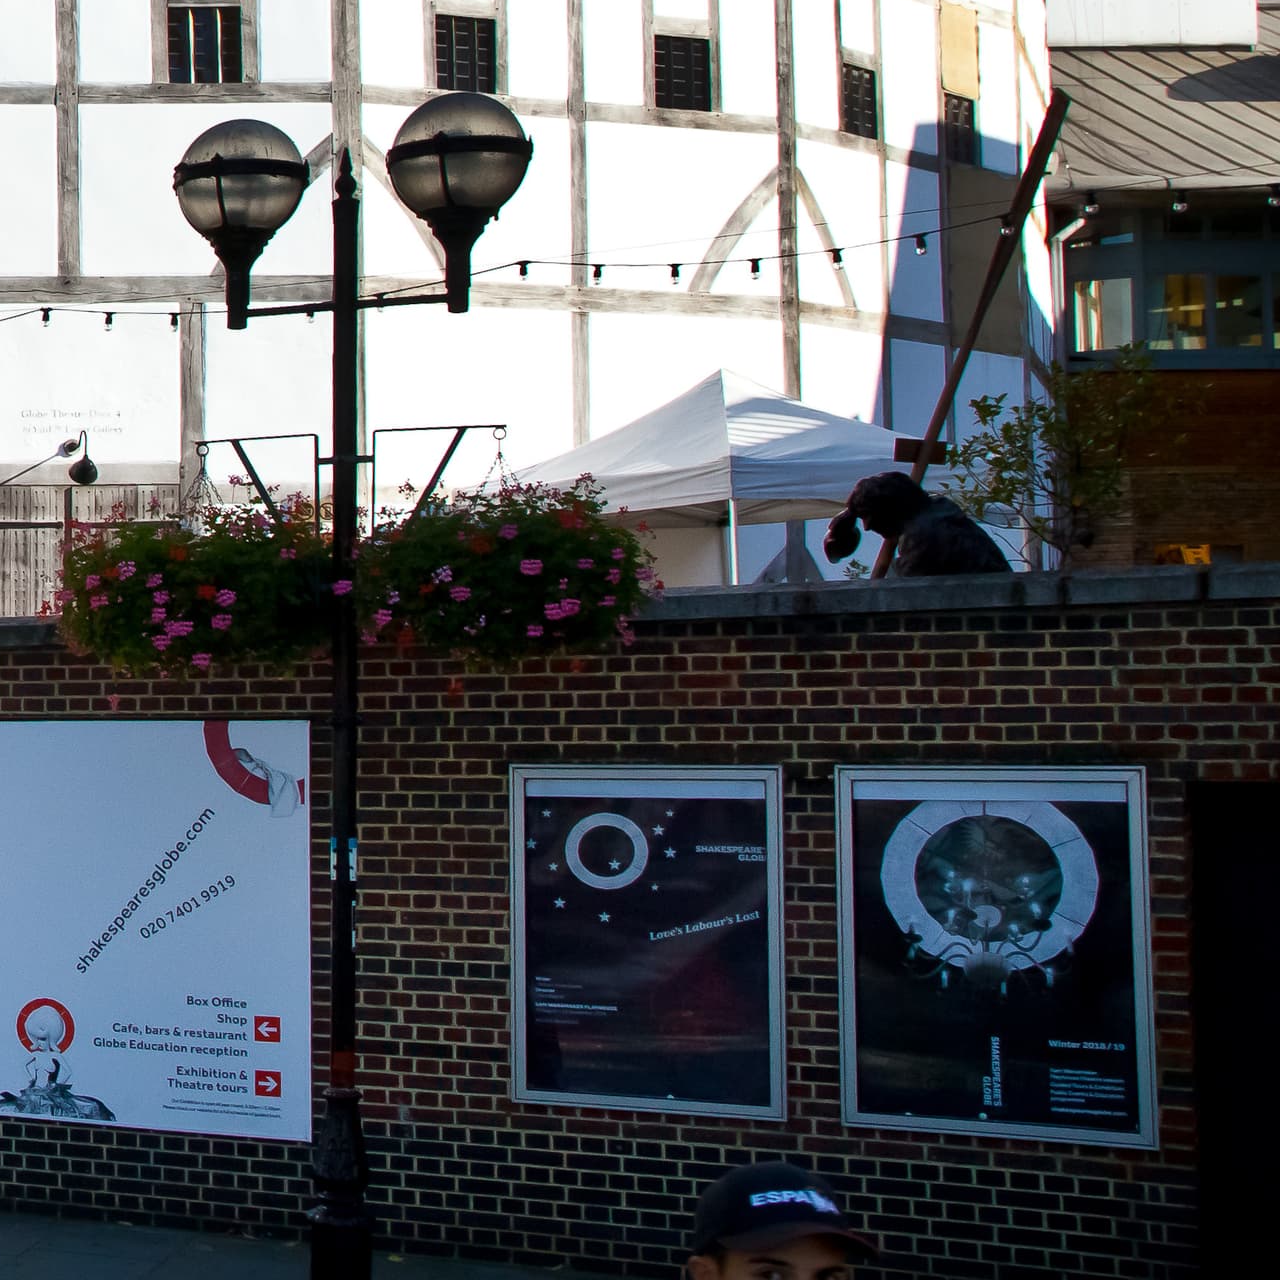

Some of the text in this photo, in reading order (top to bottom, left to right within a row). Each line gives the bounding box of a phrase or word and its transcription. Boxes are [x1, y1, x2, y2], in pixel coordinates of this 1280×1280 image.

[76, 808, 215, 973] shakespearesglobe.com
[140, 875, 235, 939] 020 7401 9919
[649, 911, 761, 941] Love's Labour's Lost
[187, 996, 247, 1009] Box Office
[217, 1014, 247, 1027] Shop
[112, 1023, 247, 1041] Cafe, bars & restaurant
[93, 1037, 248, 1057] Globe Education reception
[1048, 1039, 1080, 1048] Winter
[176, 1066, 248, 1080] Exhibition &
[991, 1036, 1002, 1107] SHAKESPEARE'S
[167, 1078, 248, 1094] Theatre tours
[983, 1076, 992, 1106] GLOBE
